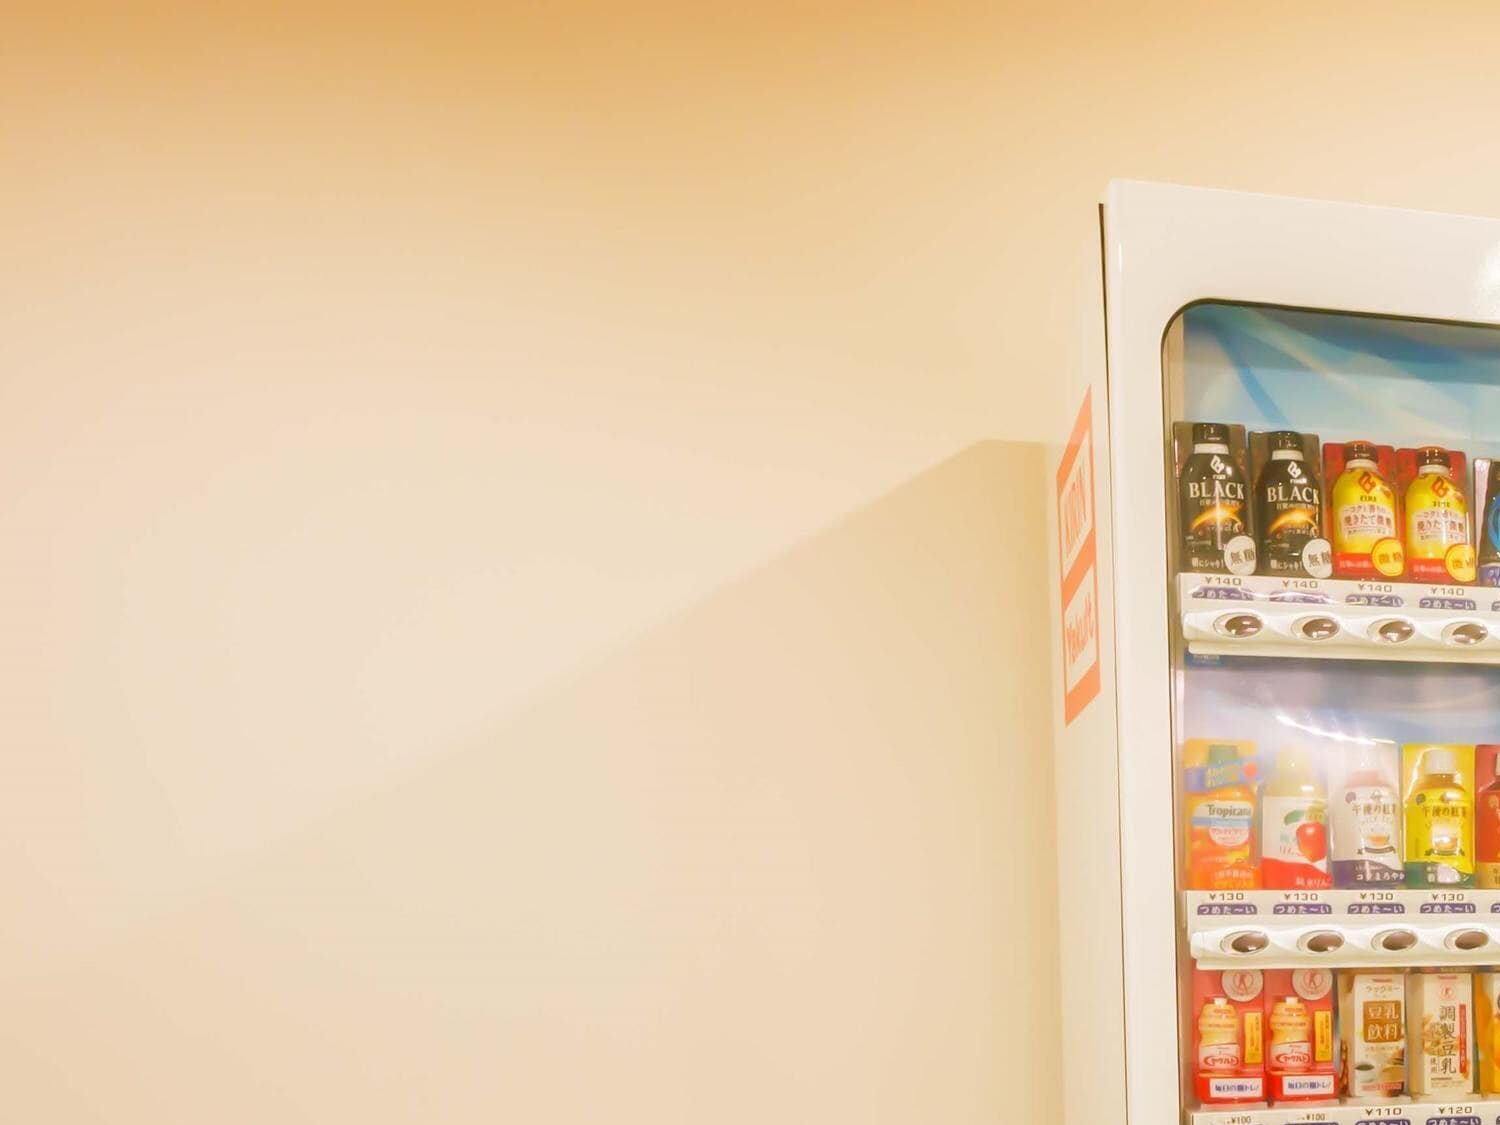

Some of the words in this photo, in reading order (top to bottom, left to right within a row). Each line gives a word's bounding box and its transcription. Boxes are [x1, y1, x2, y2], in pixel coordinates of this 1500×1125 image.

[1188, 481, 1245, 500] BLACK
[1266, 485, 1320, 505] BLACK
[1204, 576, 1242, 587] ¥140
[1282, 579, 1319, 590] ¥140
[1358, 583, 1393, 593] ¥140
[1431, 586, 1465, 597] ¥140
[1209, 893, 1244, 901] ¥130
[1284, 893, 1318, 901] ¥130
[1360, 893, 1393, 901] ¥130
[1431, 893, 1465, 901] ¥130
[1199, 904, 1256, 914] つめた〜い
[1276, 904, 1330, 914] つめた〜い
[1350, 904, 1403, 914] つめた〜い
[1422, 904, 1474, 913] つめた〜い
[1367, 1002, 1399, 1020] 豆乳
[1367, 1022, 1399, 1041] 飲料
[1440, 1005, 1457, 1075] 調製豆乳
[1365, 1107, 1402, 1116] ¥110
[1438, 1106, 1473, 1115] ¥120
[1231, 1115, 1252, 1124] ¥100
[1306, 1112, 1326, 1121] ¥100
[1428, 1117, 1479, 1125] つめた〜い
